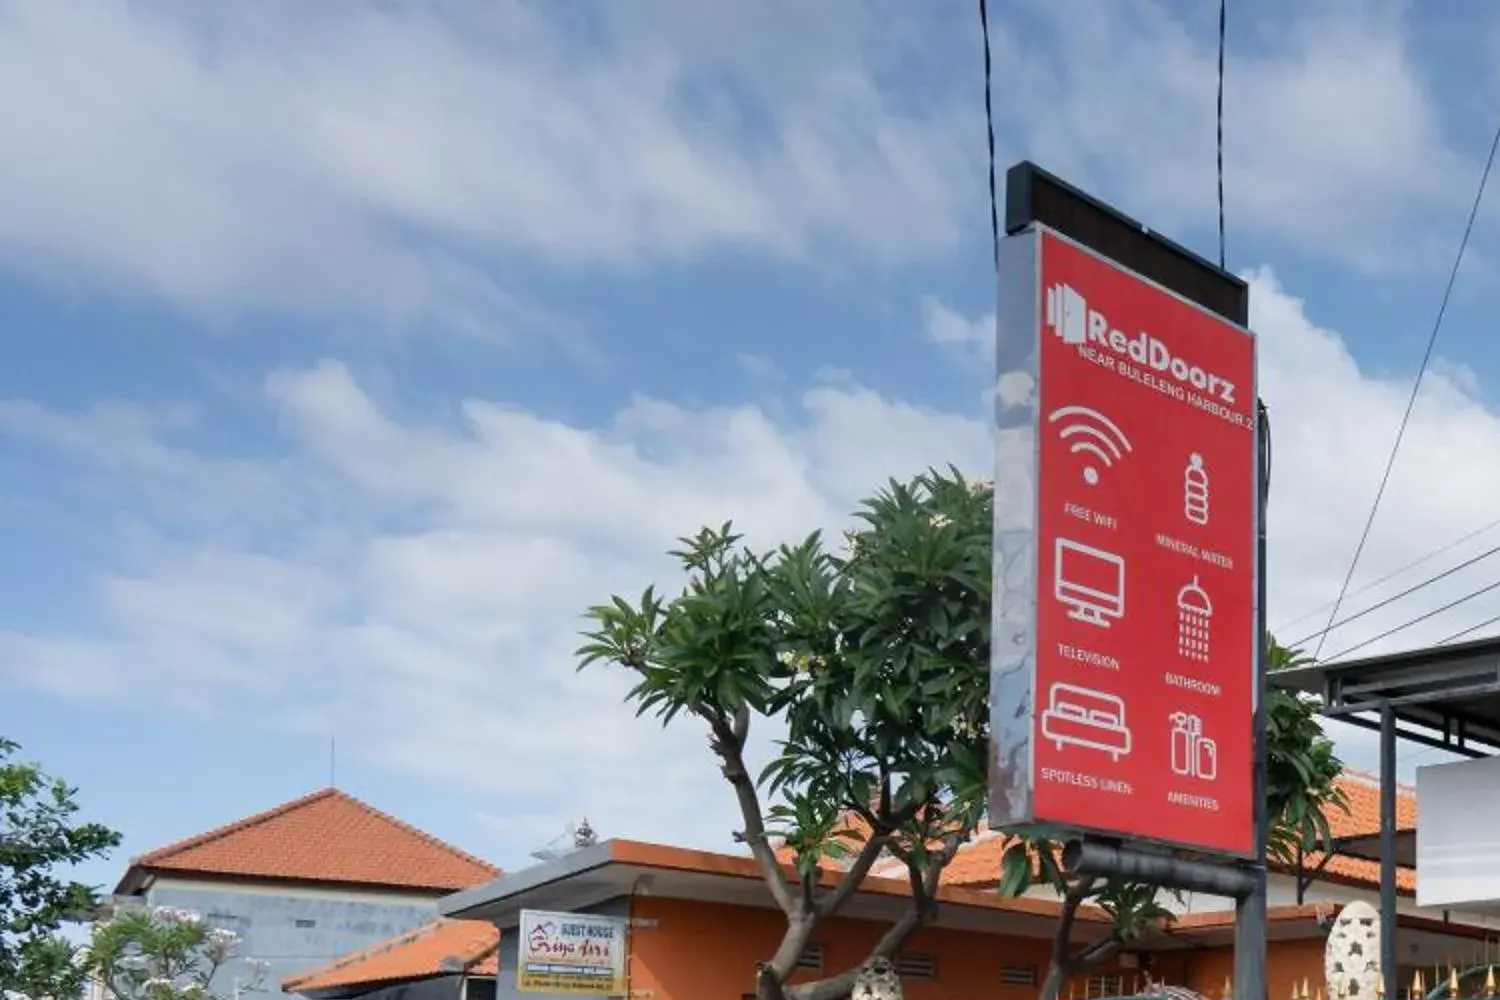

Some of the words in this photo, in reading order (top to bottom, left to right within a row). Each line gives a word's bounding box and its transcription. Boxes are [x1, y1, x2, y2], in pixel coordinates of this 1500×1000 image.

[1088, 309, 1236, 403] RedDoorz
[1077, 344, 1115, 371] NEAR
[1117, 363, 1185, 401] BULELENG
[1187, 391, 1244, 426] HARBOUR
[1064, 503, 1092, 522] FREE
[1156, 533, 1199, 557] MINERAL
[1201, 549, 1233, 570] WATER
[1057, 643, 1119, 671] TELEVISION
[1165, 672, 1221, 696] BATHROOM
[1040, 767, 1098, 789] SPOTLESS
[1099, 778, 1131, 795] LINEN
[1167, 791, 1219, 810] AMENITIES
[588, 925, 614, 939] HOUSE
